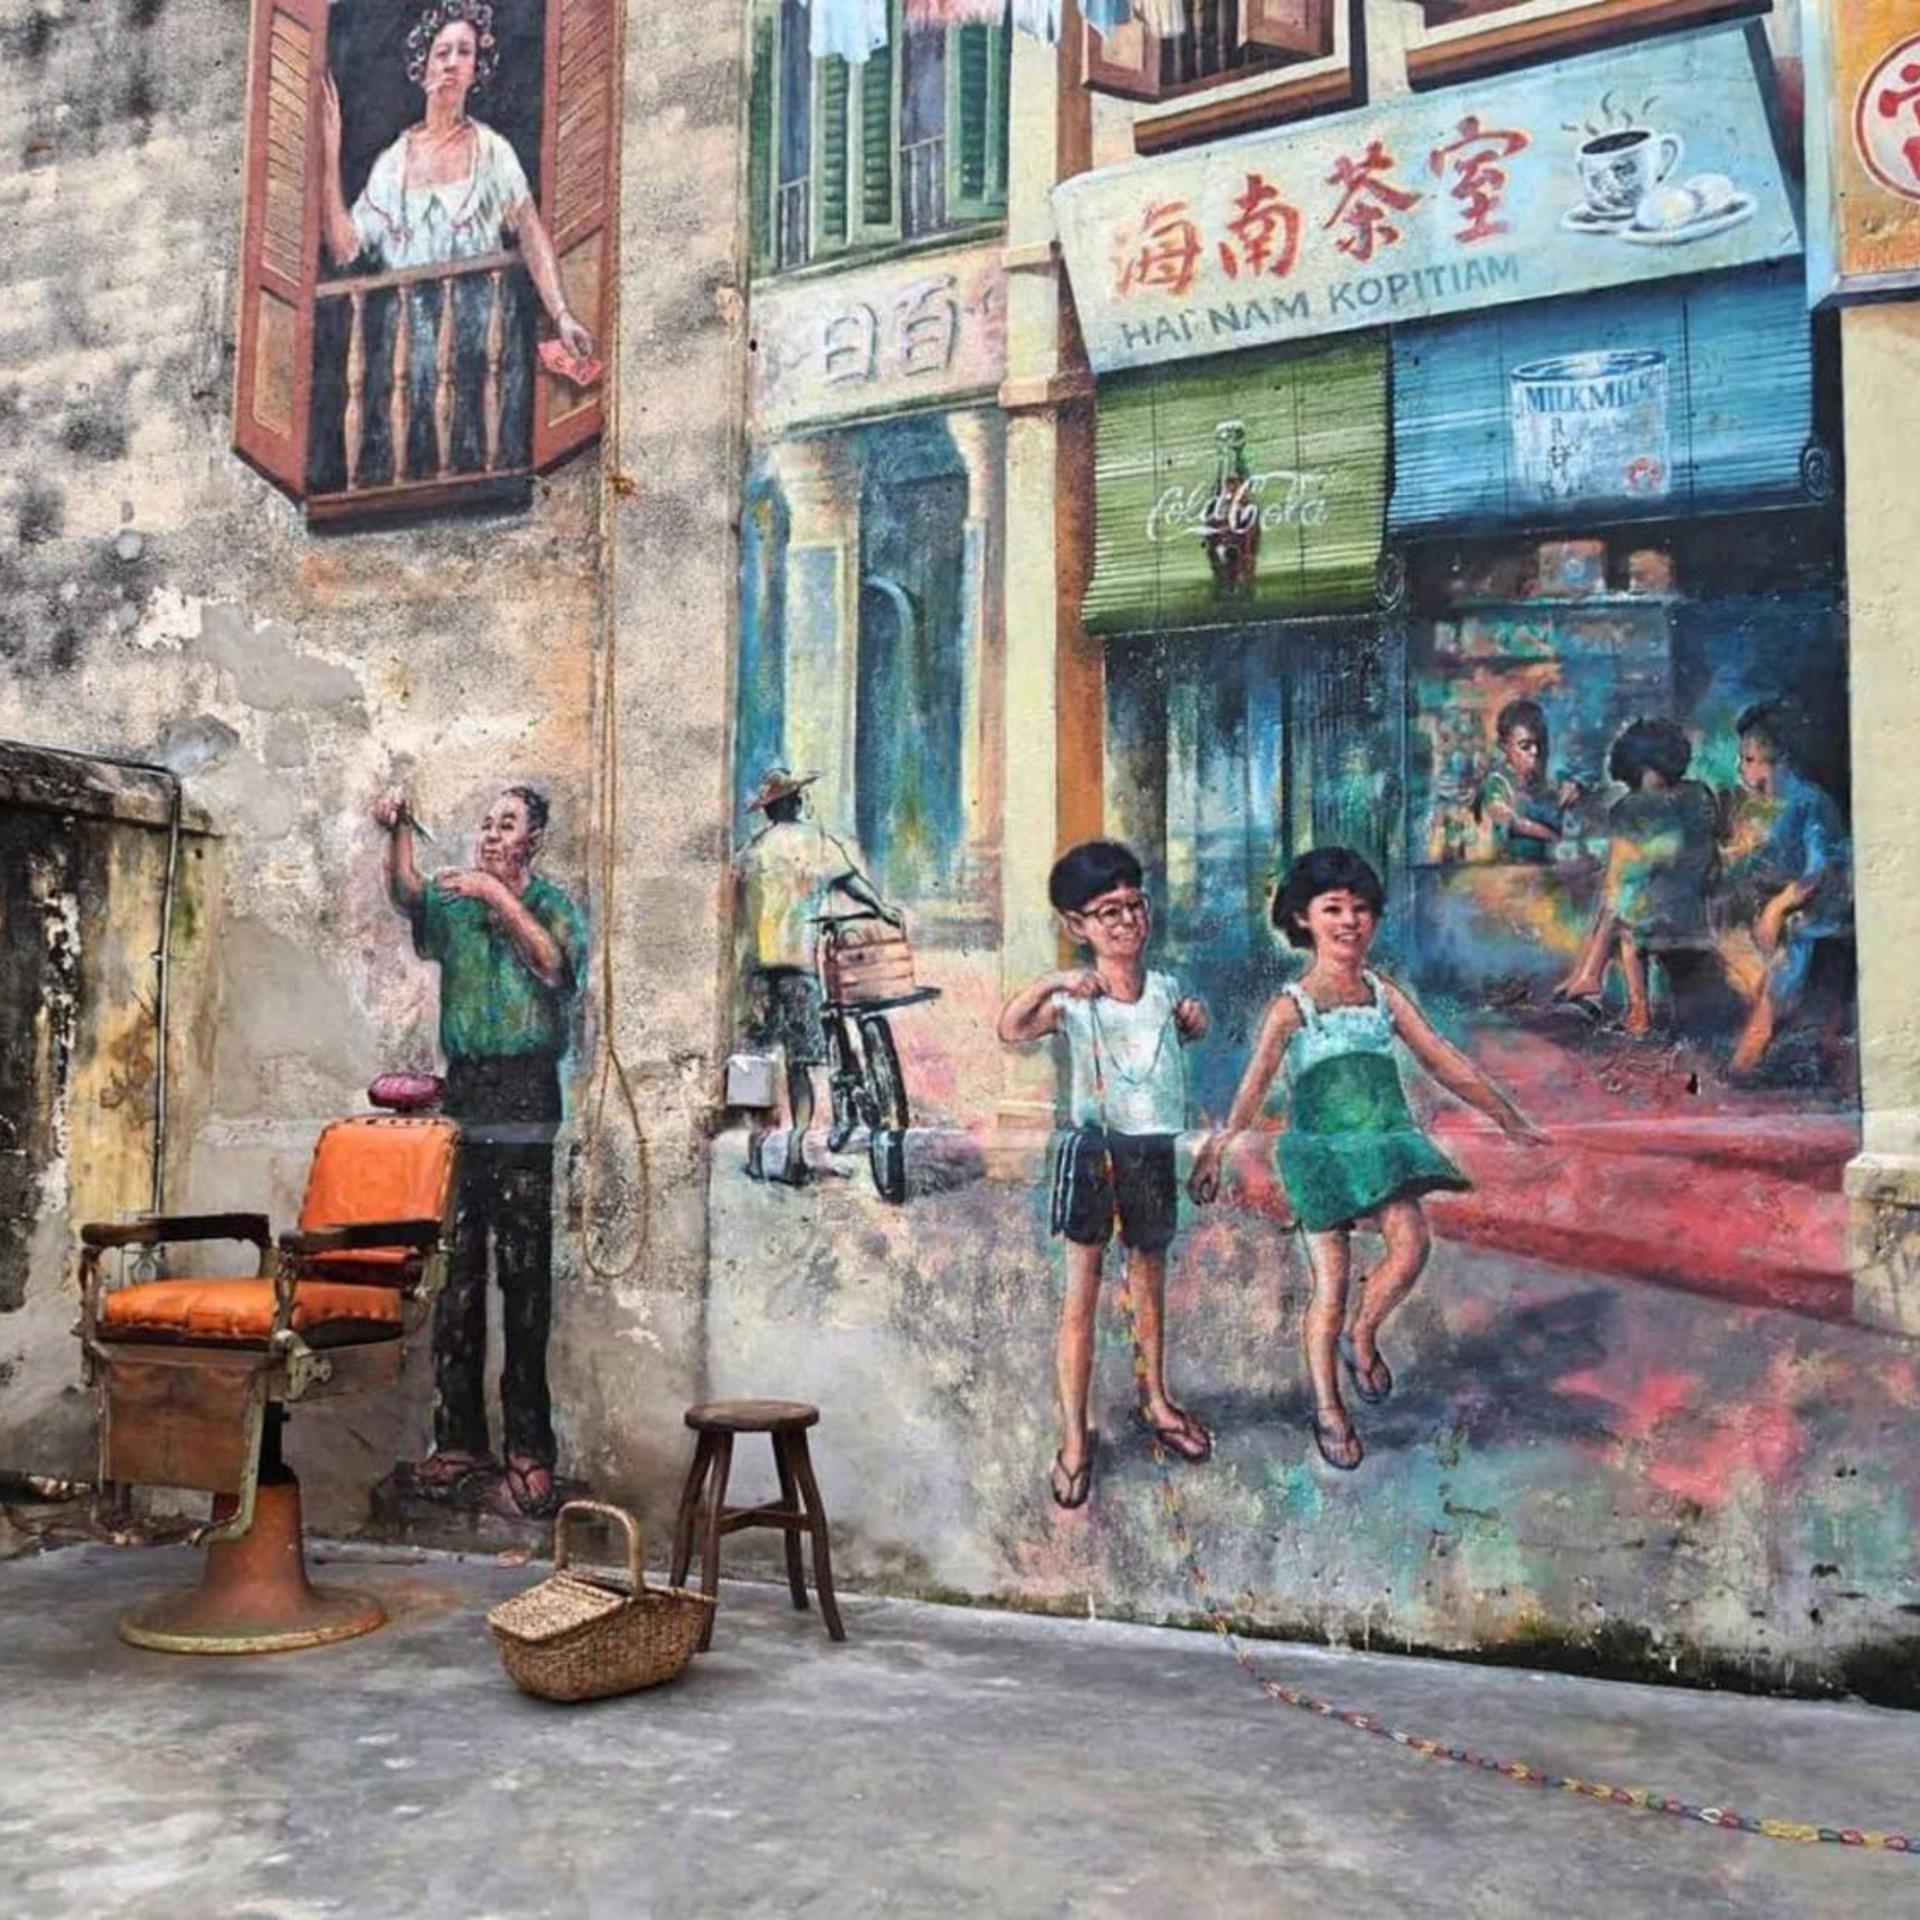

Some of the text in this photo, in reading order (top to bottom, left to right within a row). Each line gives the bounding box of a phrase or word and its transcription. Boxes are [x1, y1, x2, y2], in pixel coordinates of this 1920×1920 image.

[1111, 115, 1530, 298] 海南茶室
[1211, 291, 1310, 335] NAM
[1329, 253, 1520, 315] KOPITIAM
